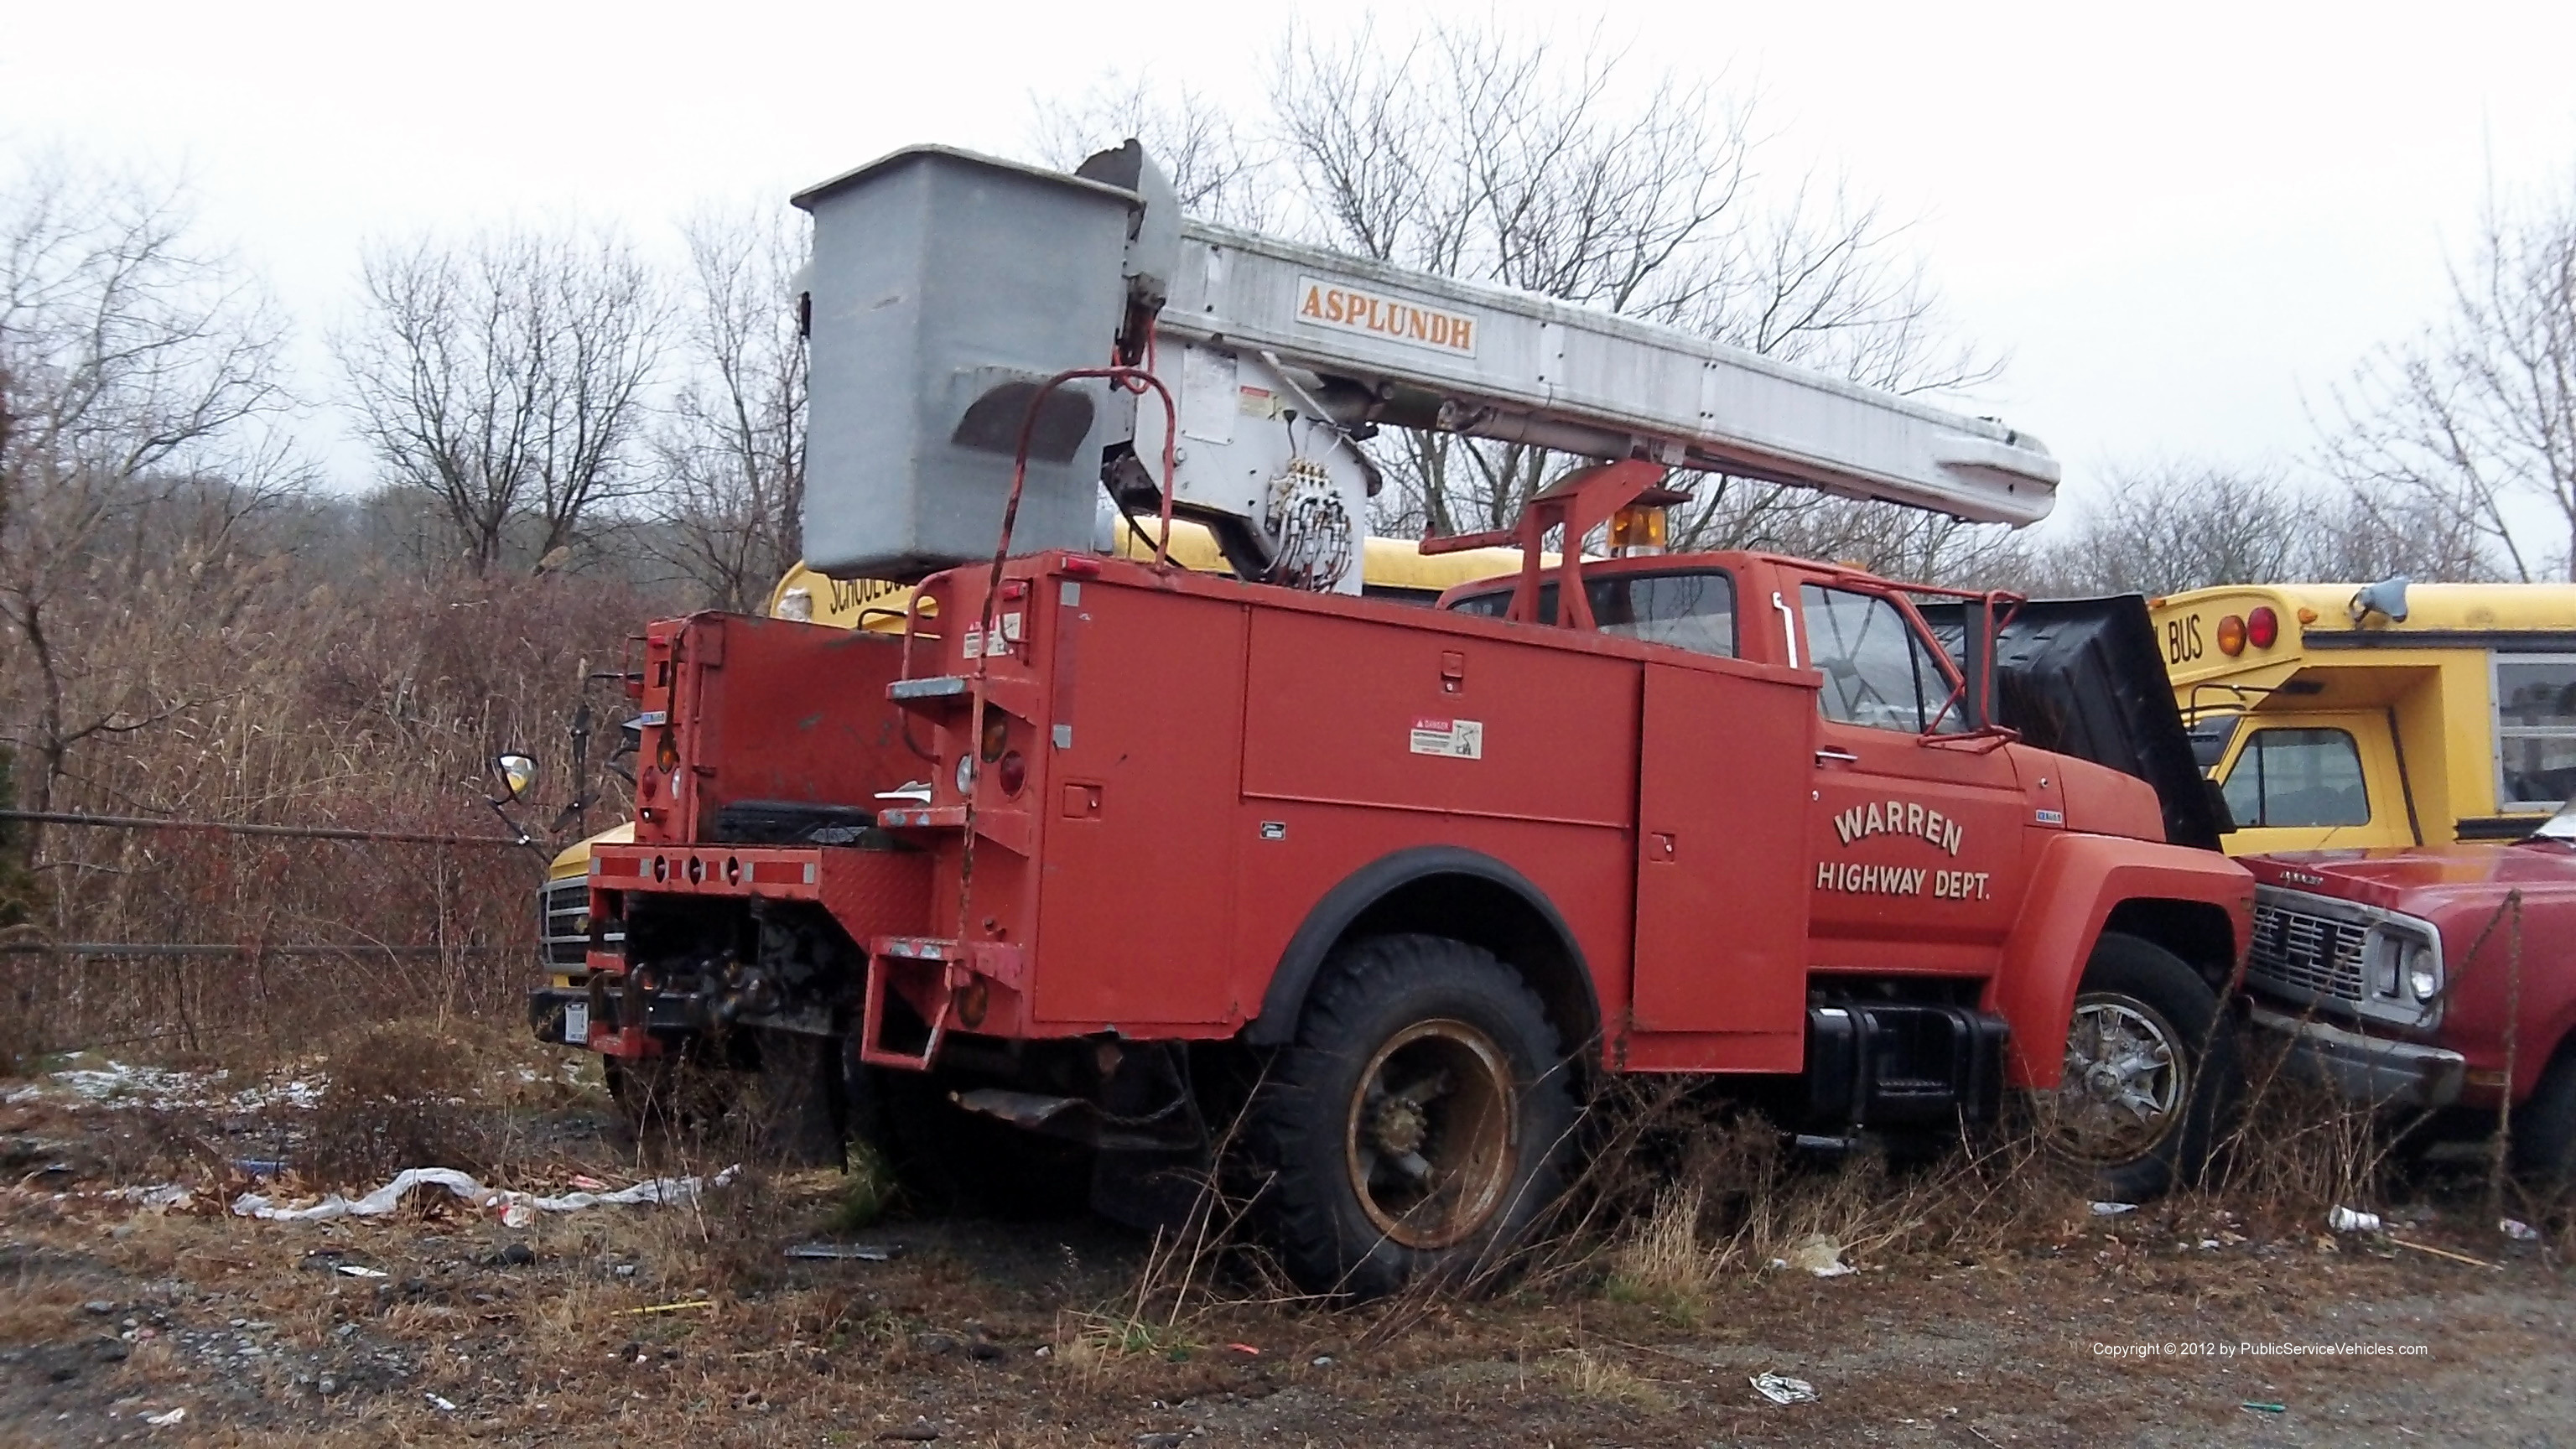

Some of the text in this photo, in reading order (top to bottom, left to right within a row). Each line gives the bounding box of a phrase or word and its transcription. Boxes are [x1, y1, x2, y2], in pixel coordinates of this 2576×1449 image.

[1301, 285, 1472, 350] ASPLUNDH
[2168, 614, 2203, 665] BUS
[1834, 801, 1963, 857] WARREN
[1816, 861, 1991, 901] HIGHWAY DEPT.
